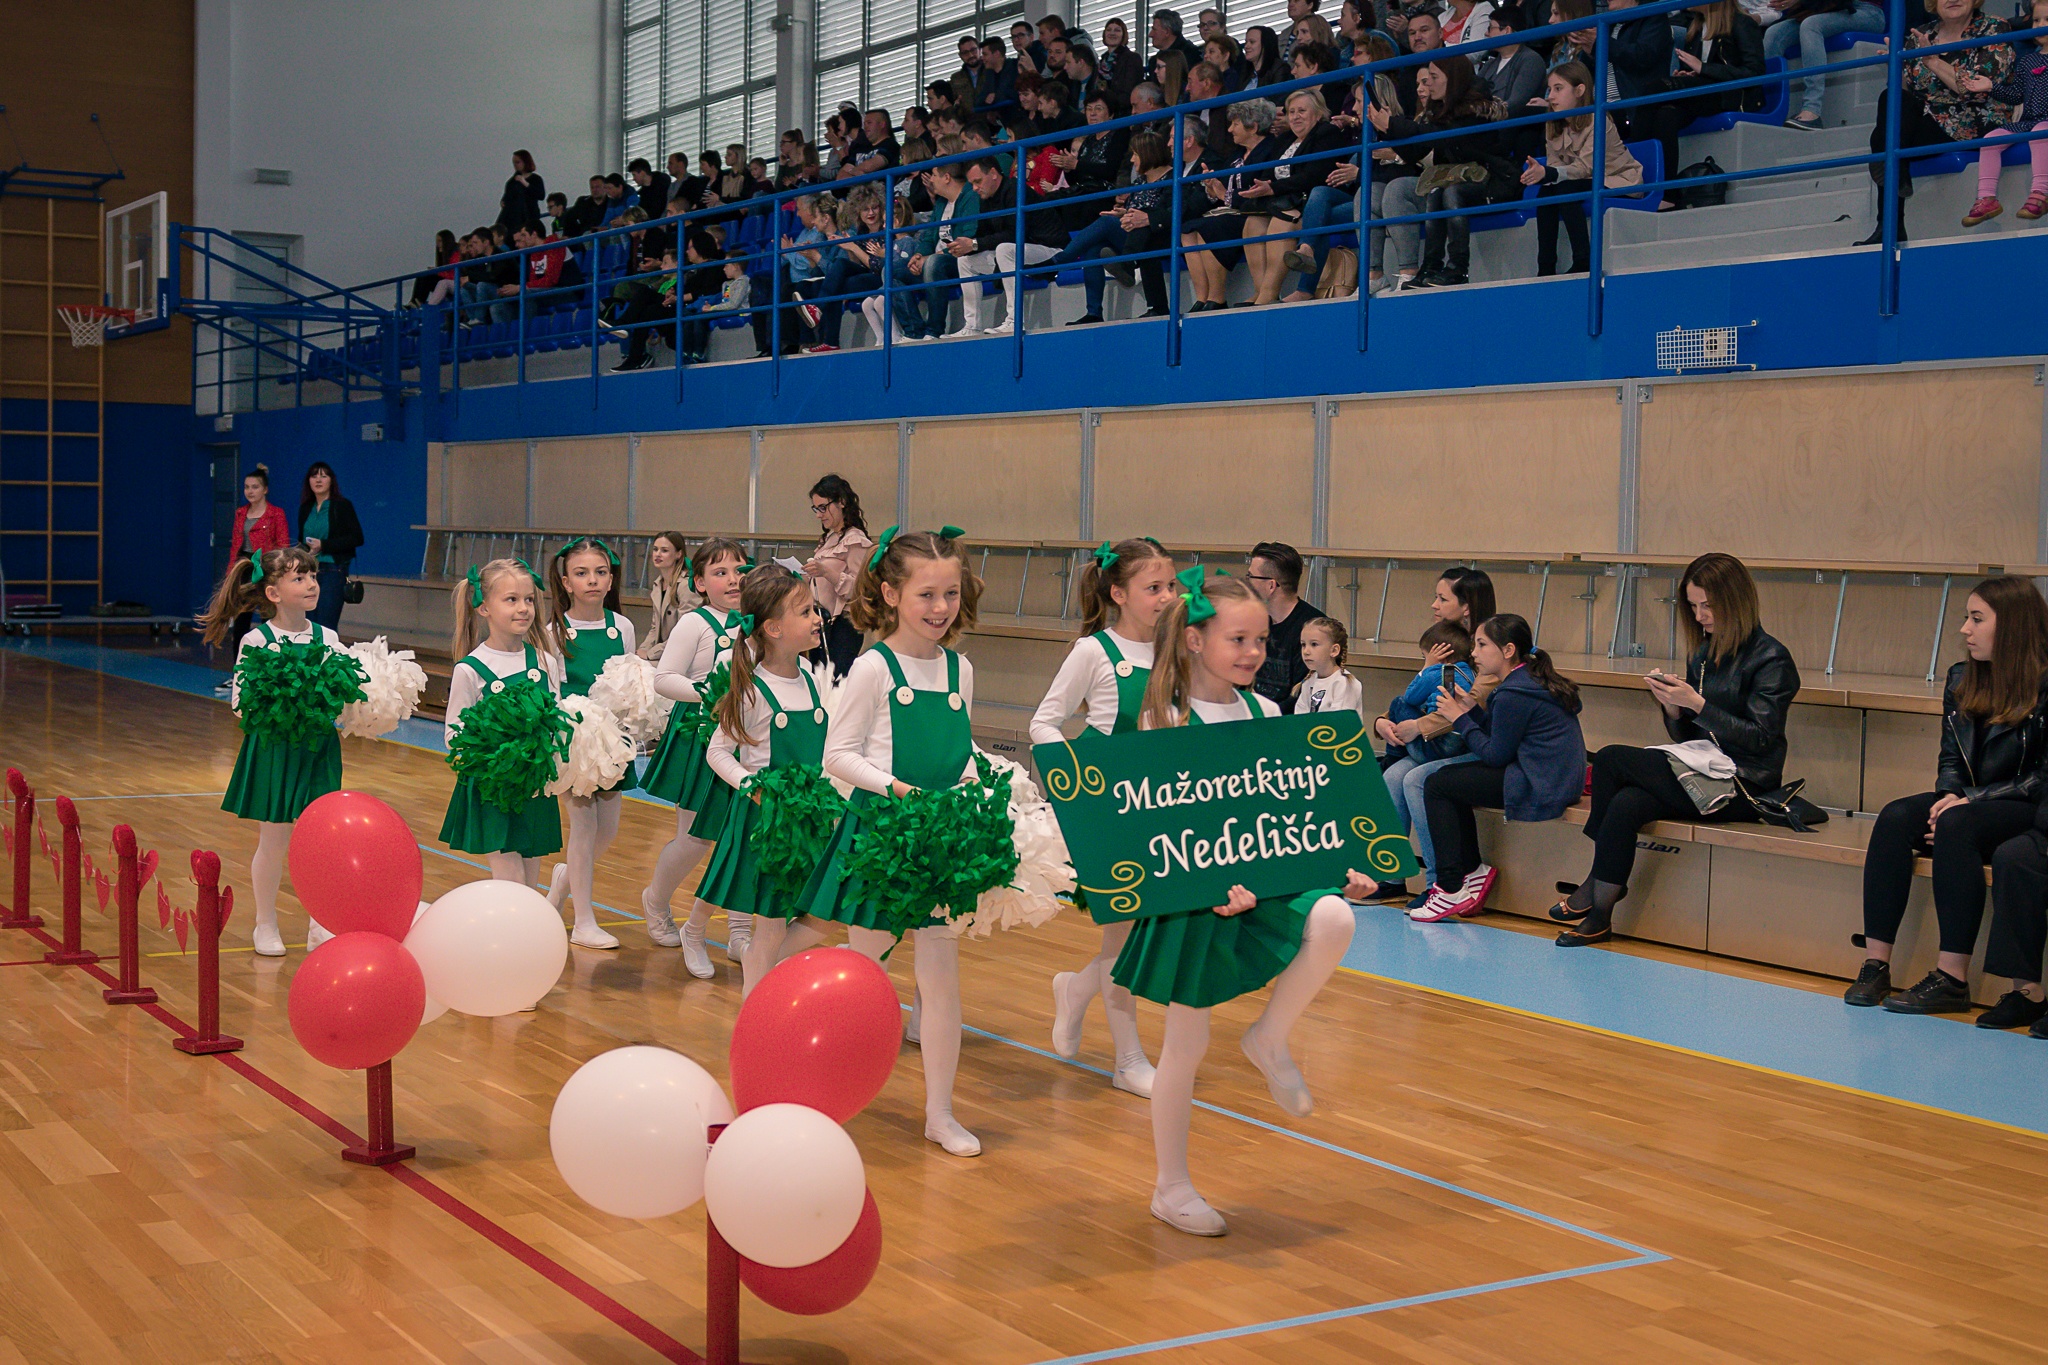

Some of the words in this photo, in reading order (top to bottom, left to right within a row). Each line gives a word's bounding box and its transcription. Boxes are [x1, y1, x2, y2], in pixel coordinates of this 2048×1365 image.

[992, 743, 1017, 752] elan
[1112, 756, 1331, 815] Mažoretkinje
[1148, 811, 1345, 878] Nedelišća
[1635, 841, 1681, 854] elan
